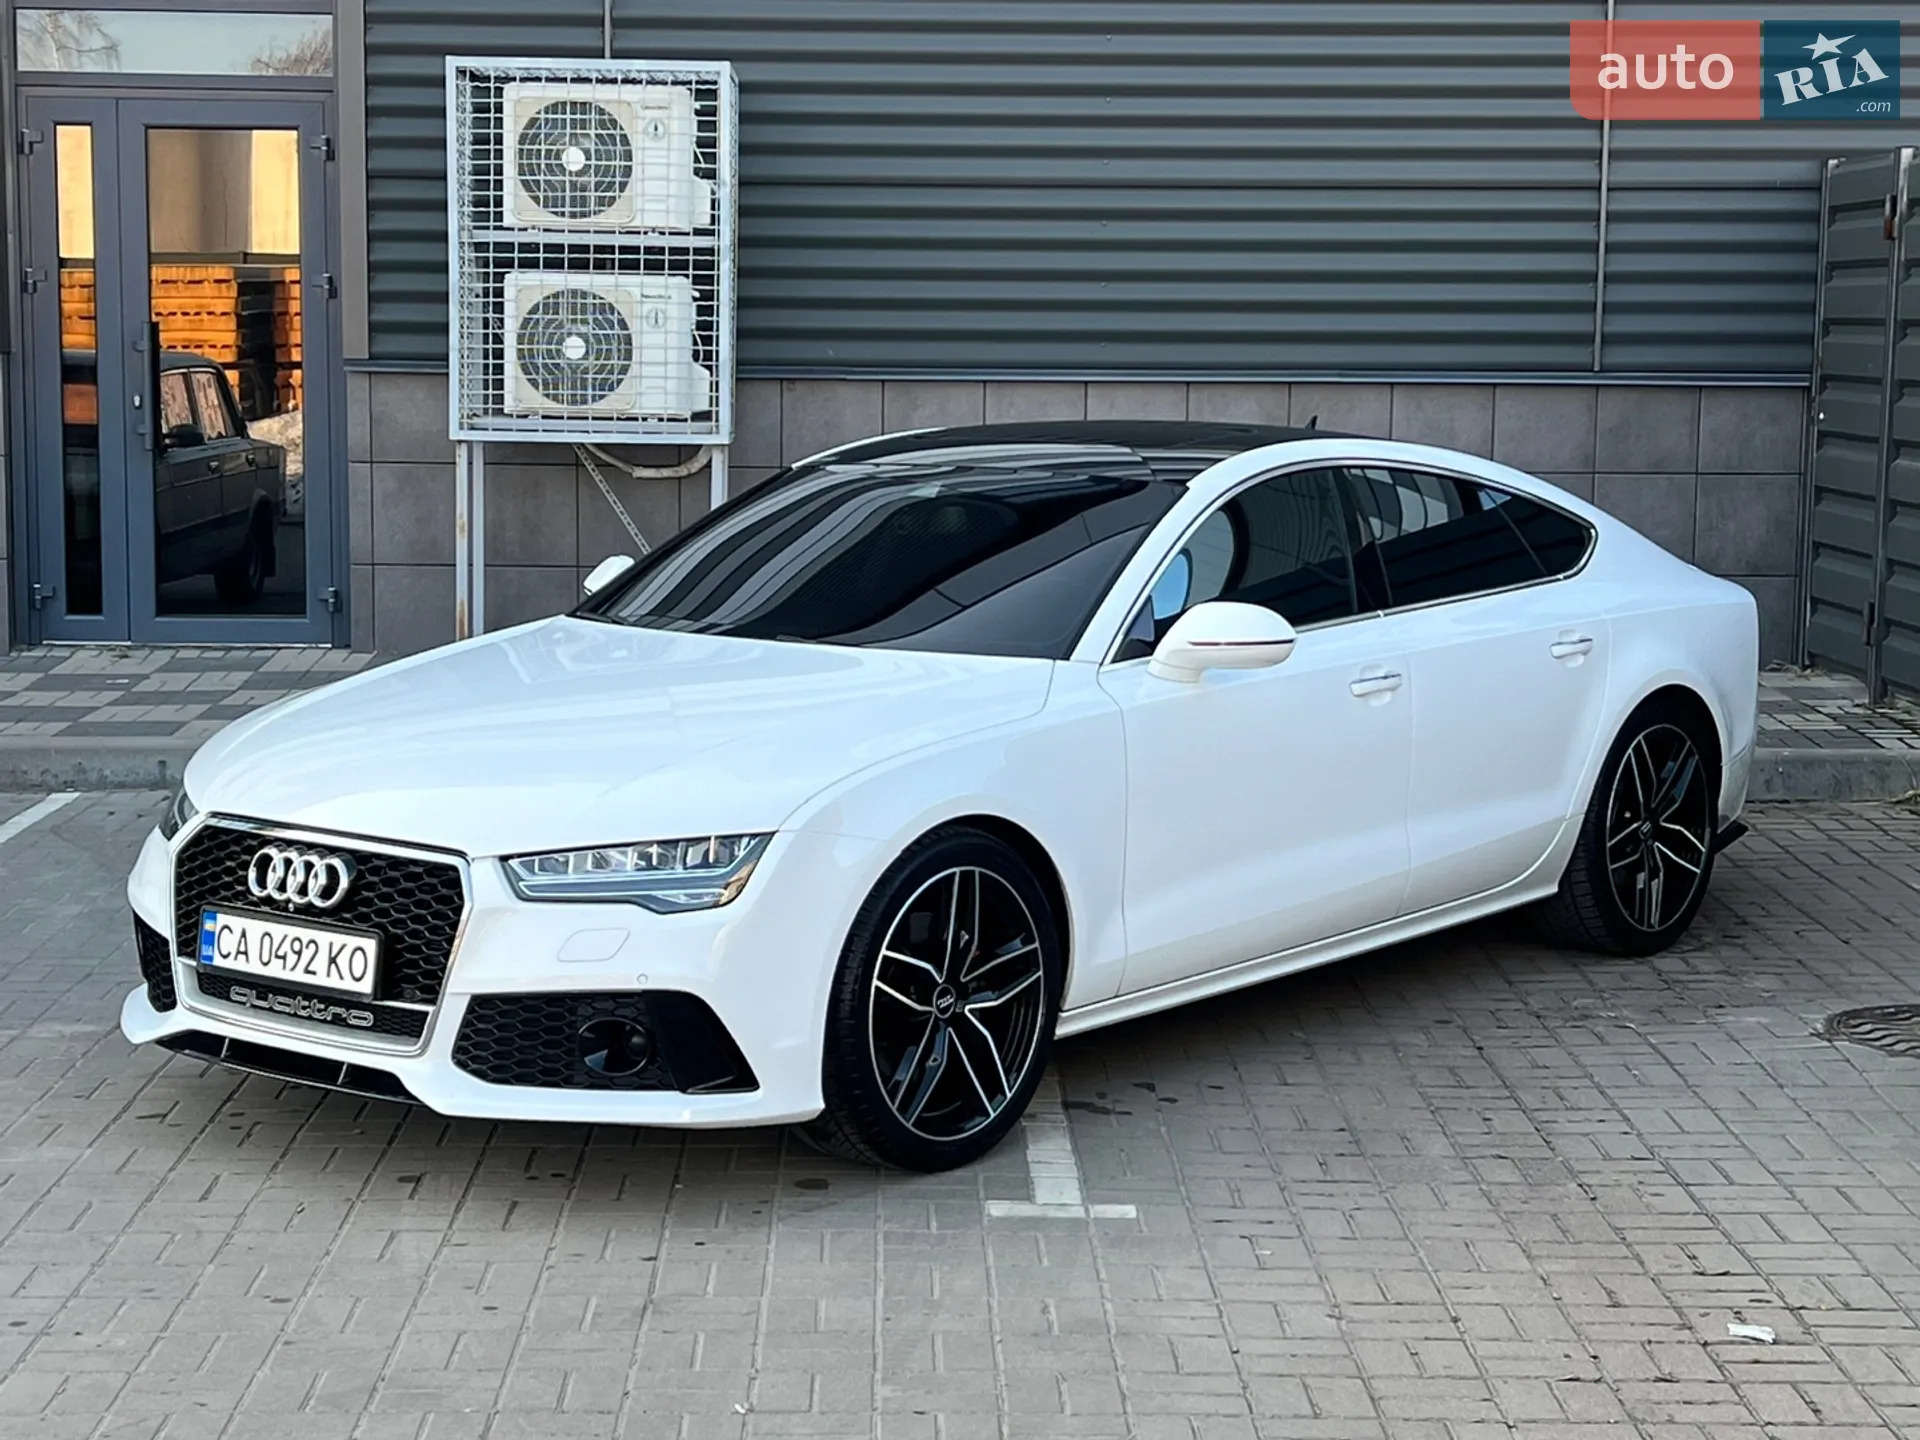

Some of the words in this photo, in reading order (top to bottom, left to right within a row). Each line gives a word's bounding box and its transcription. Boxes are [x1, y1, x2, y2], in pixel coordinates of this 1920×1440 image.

[217, 924, 250, 964] CA
[259, 931, 318, 976] 0492
[326, 941, 369, 982] KO
[230, 986, 374, 1027] quattro
